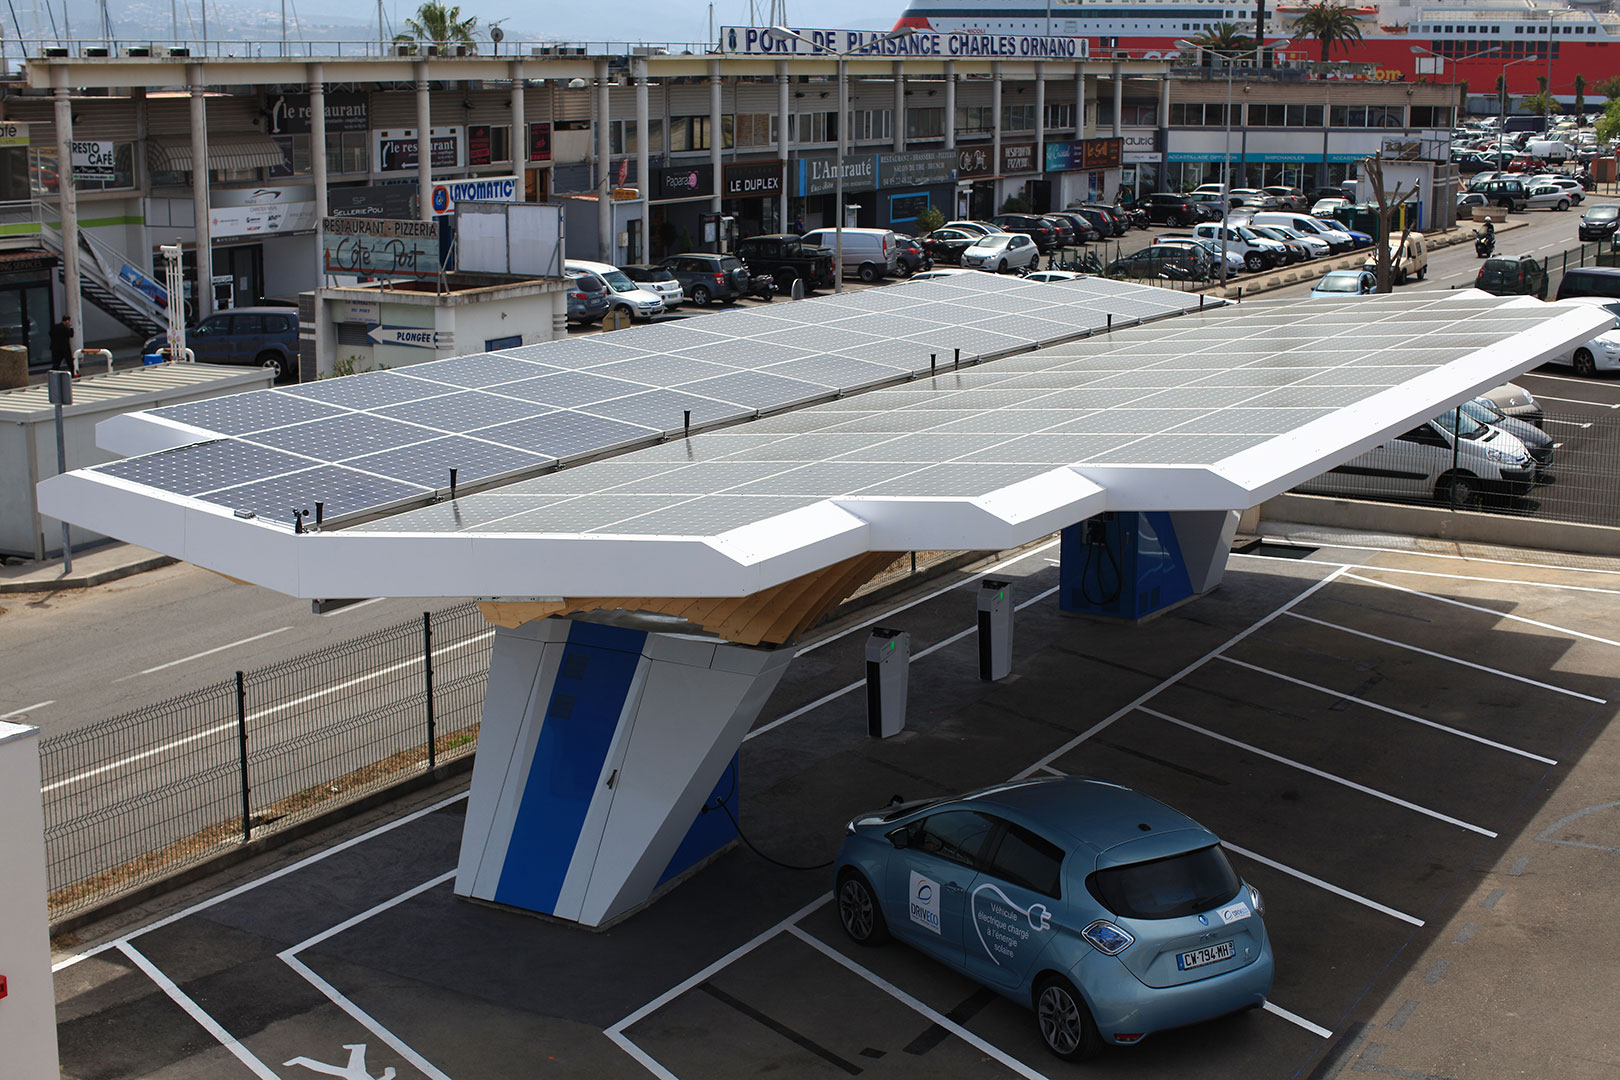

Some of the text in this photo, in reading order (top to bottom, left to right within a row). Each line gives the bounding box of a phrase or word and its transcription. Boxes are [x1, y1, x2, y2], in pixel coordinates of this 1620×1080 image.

[813, 31, 837, 53] DE
[847, 31, 941, 55] PLAISANCE
[949, 34, 1016, 56] CHARLES
[1020, 37, 1076, 57] ORNANO
[283, 103, 296, 119] le
[72, 142, 113, 165] RESTO CAFÉ
[391, 141, 400, 153] le
[730, 177, 779, 192] LE DUPLEX
[323, 219, 385, 234] RESTAURANT
[394, 221, 437, 237] PIZZERIA
[336, 236, 427, 279] Côté Port
[396, 331, 431, 343] PLONGÉE
[910, 902, 939, 927] DRIVECO
[990, 903, 1018, 922] Véhicule
[977, 910, 1029, 940] électrique chargé
[986, 926, 1018, 948] à l'énergie
[994, 942, 1014, 959] solaire
[1184, 944, 1229, 967] CW-794-MH
